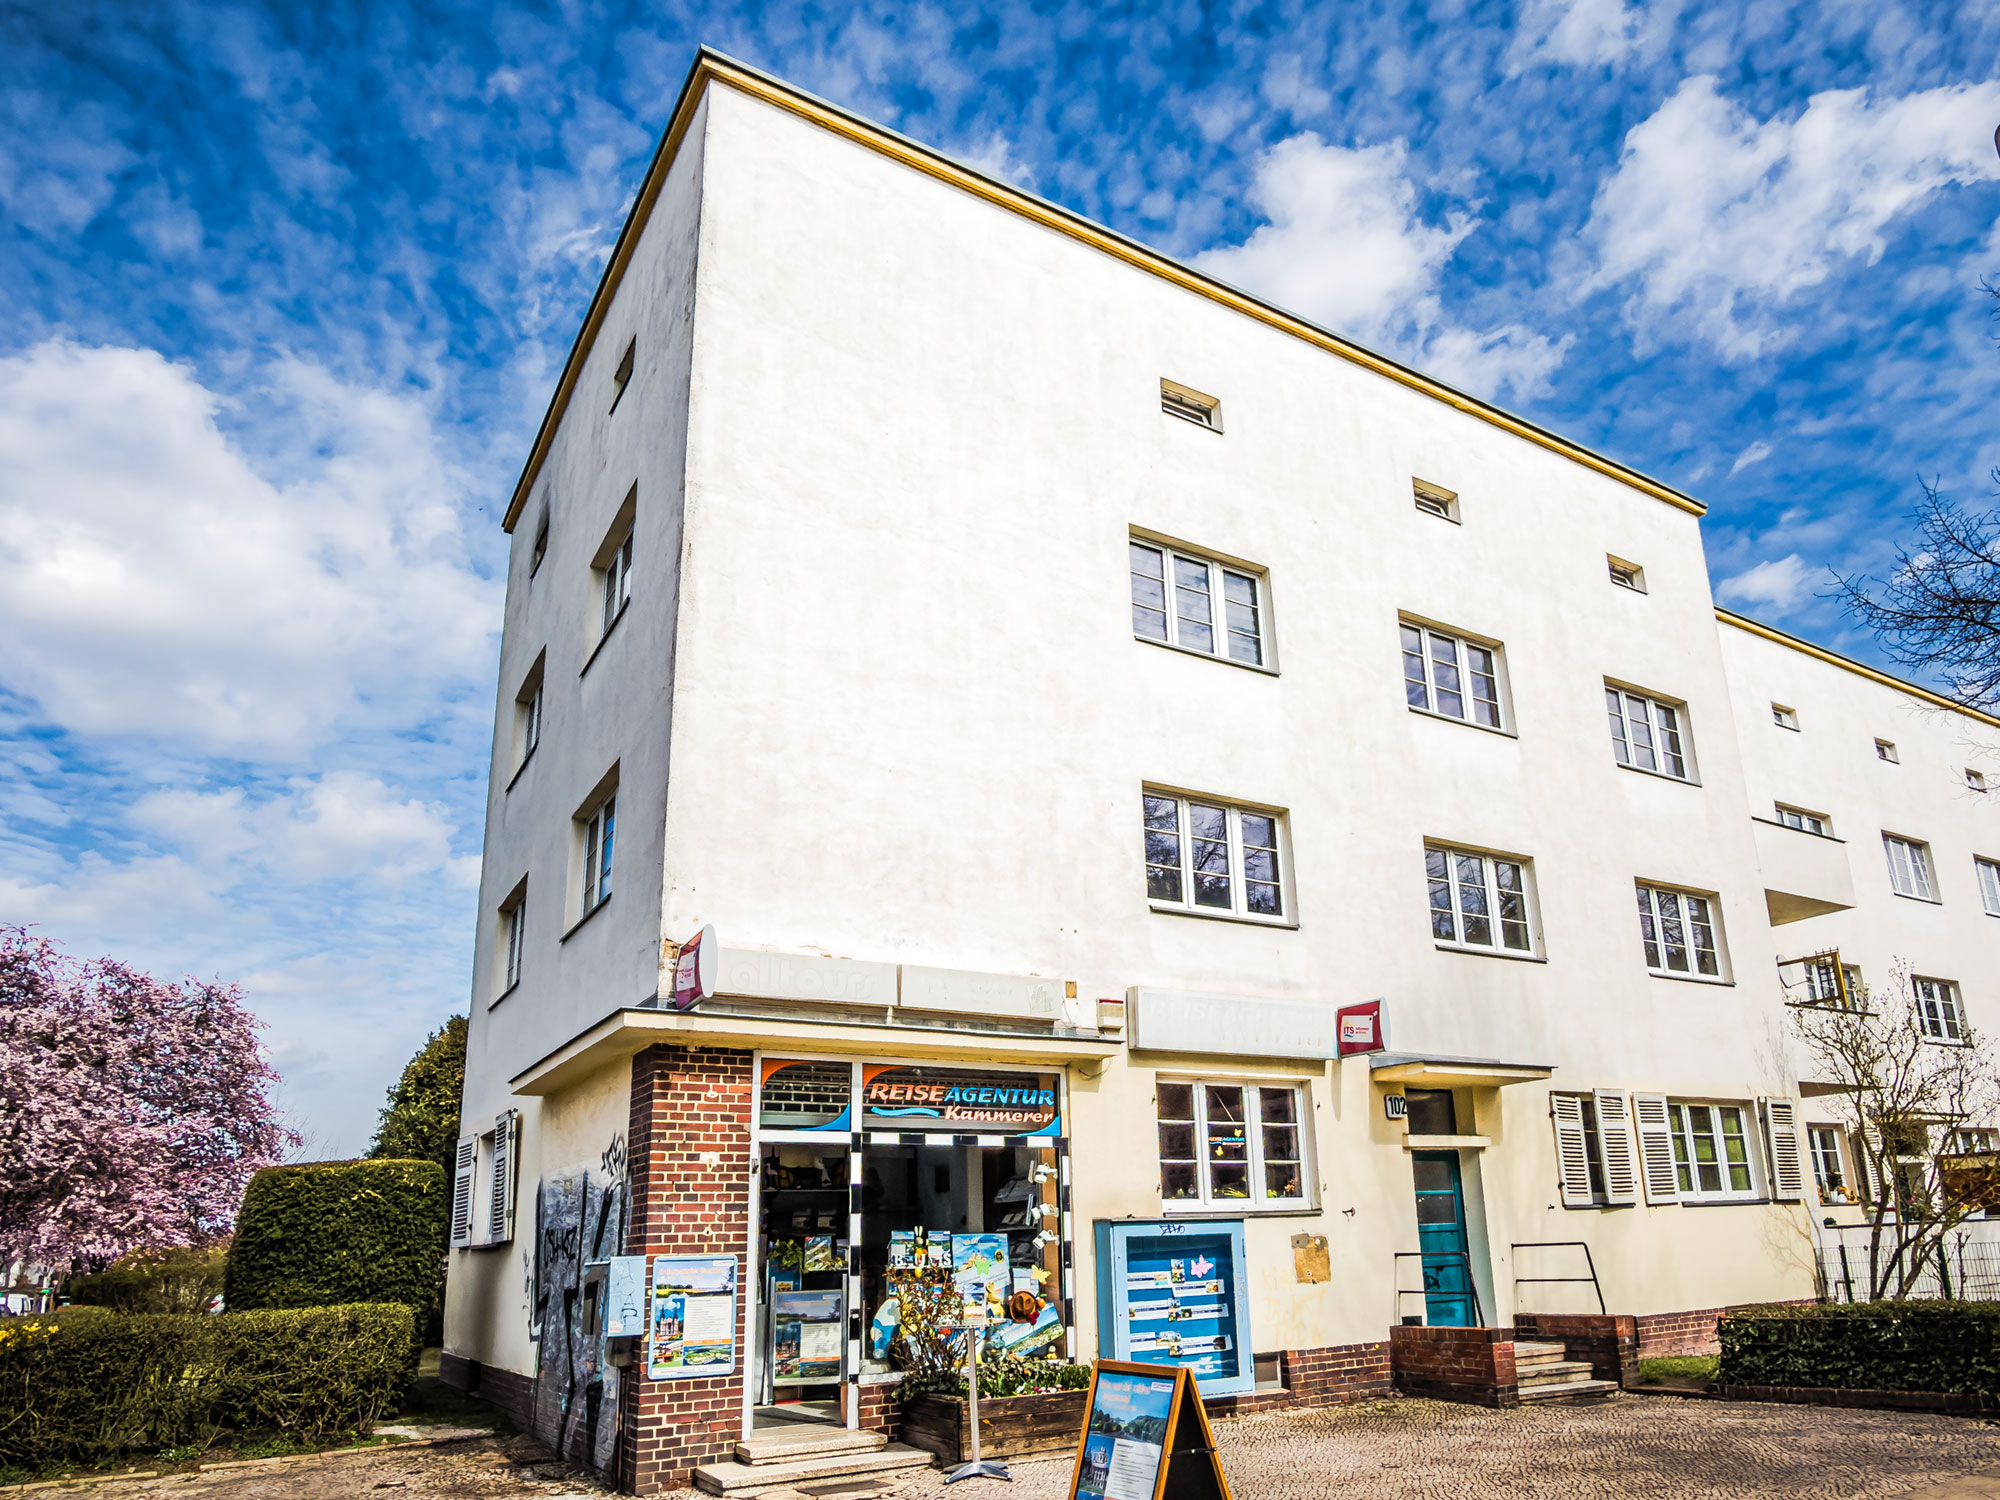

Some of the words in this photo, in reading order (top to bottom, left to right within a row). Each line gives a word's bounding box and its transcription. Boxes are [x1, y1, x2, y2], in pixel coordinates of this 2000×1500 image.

[1343, 1026, 1354, 1035] ITS
[869, 1083, 1055, 1107] REISEAGENTUR
[944, 1105, 1054, 1123] Kammerer
[1388, 1096, 1407, 1115] 102
